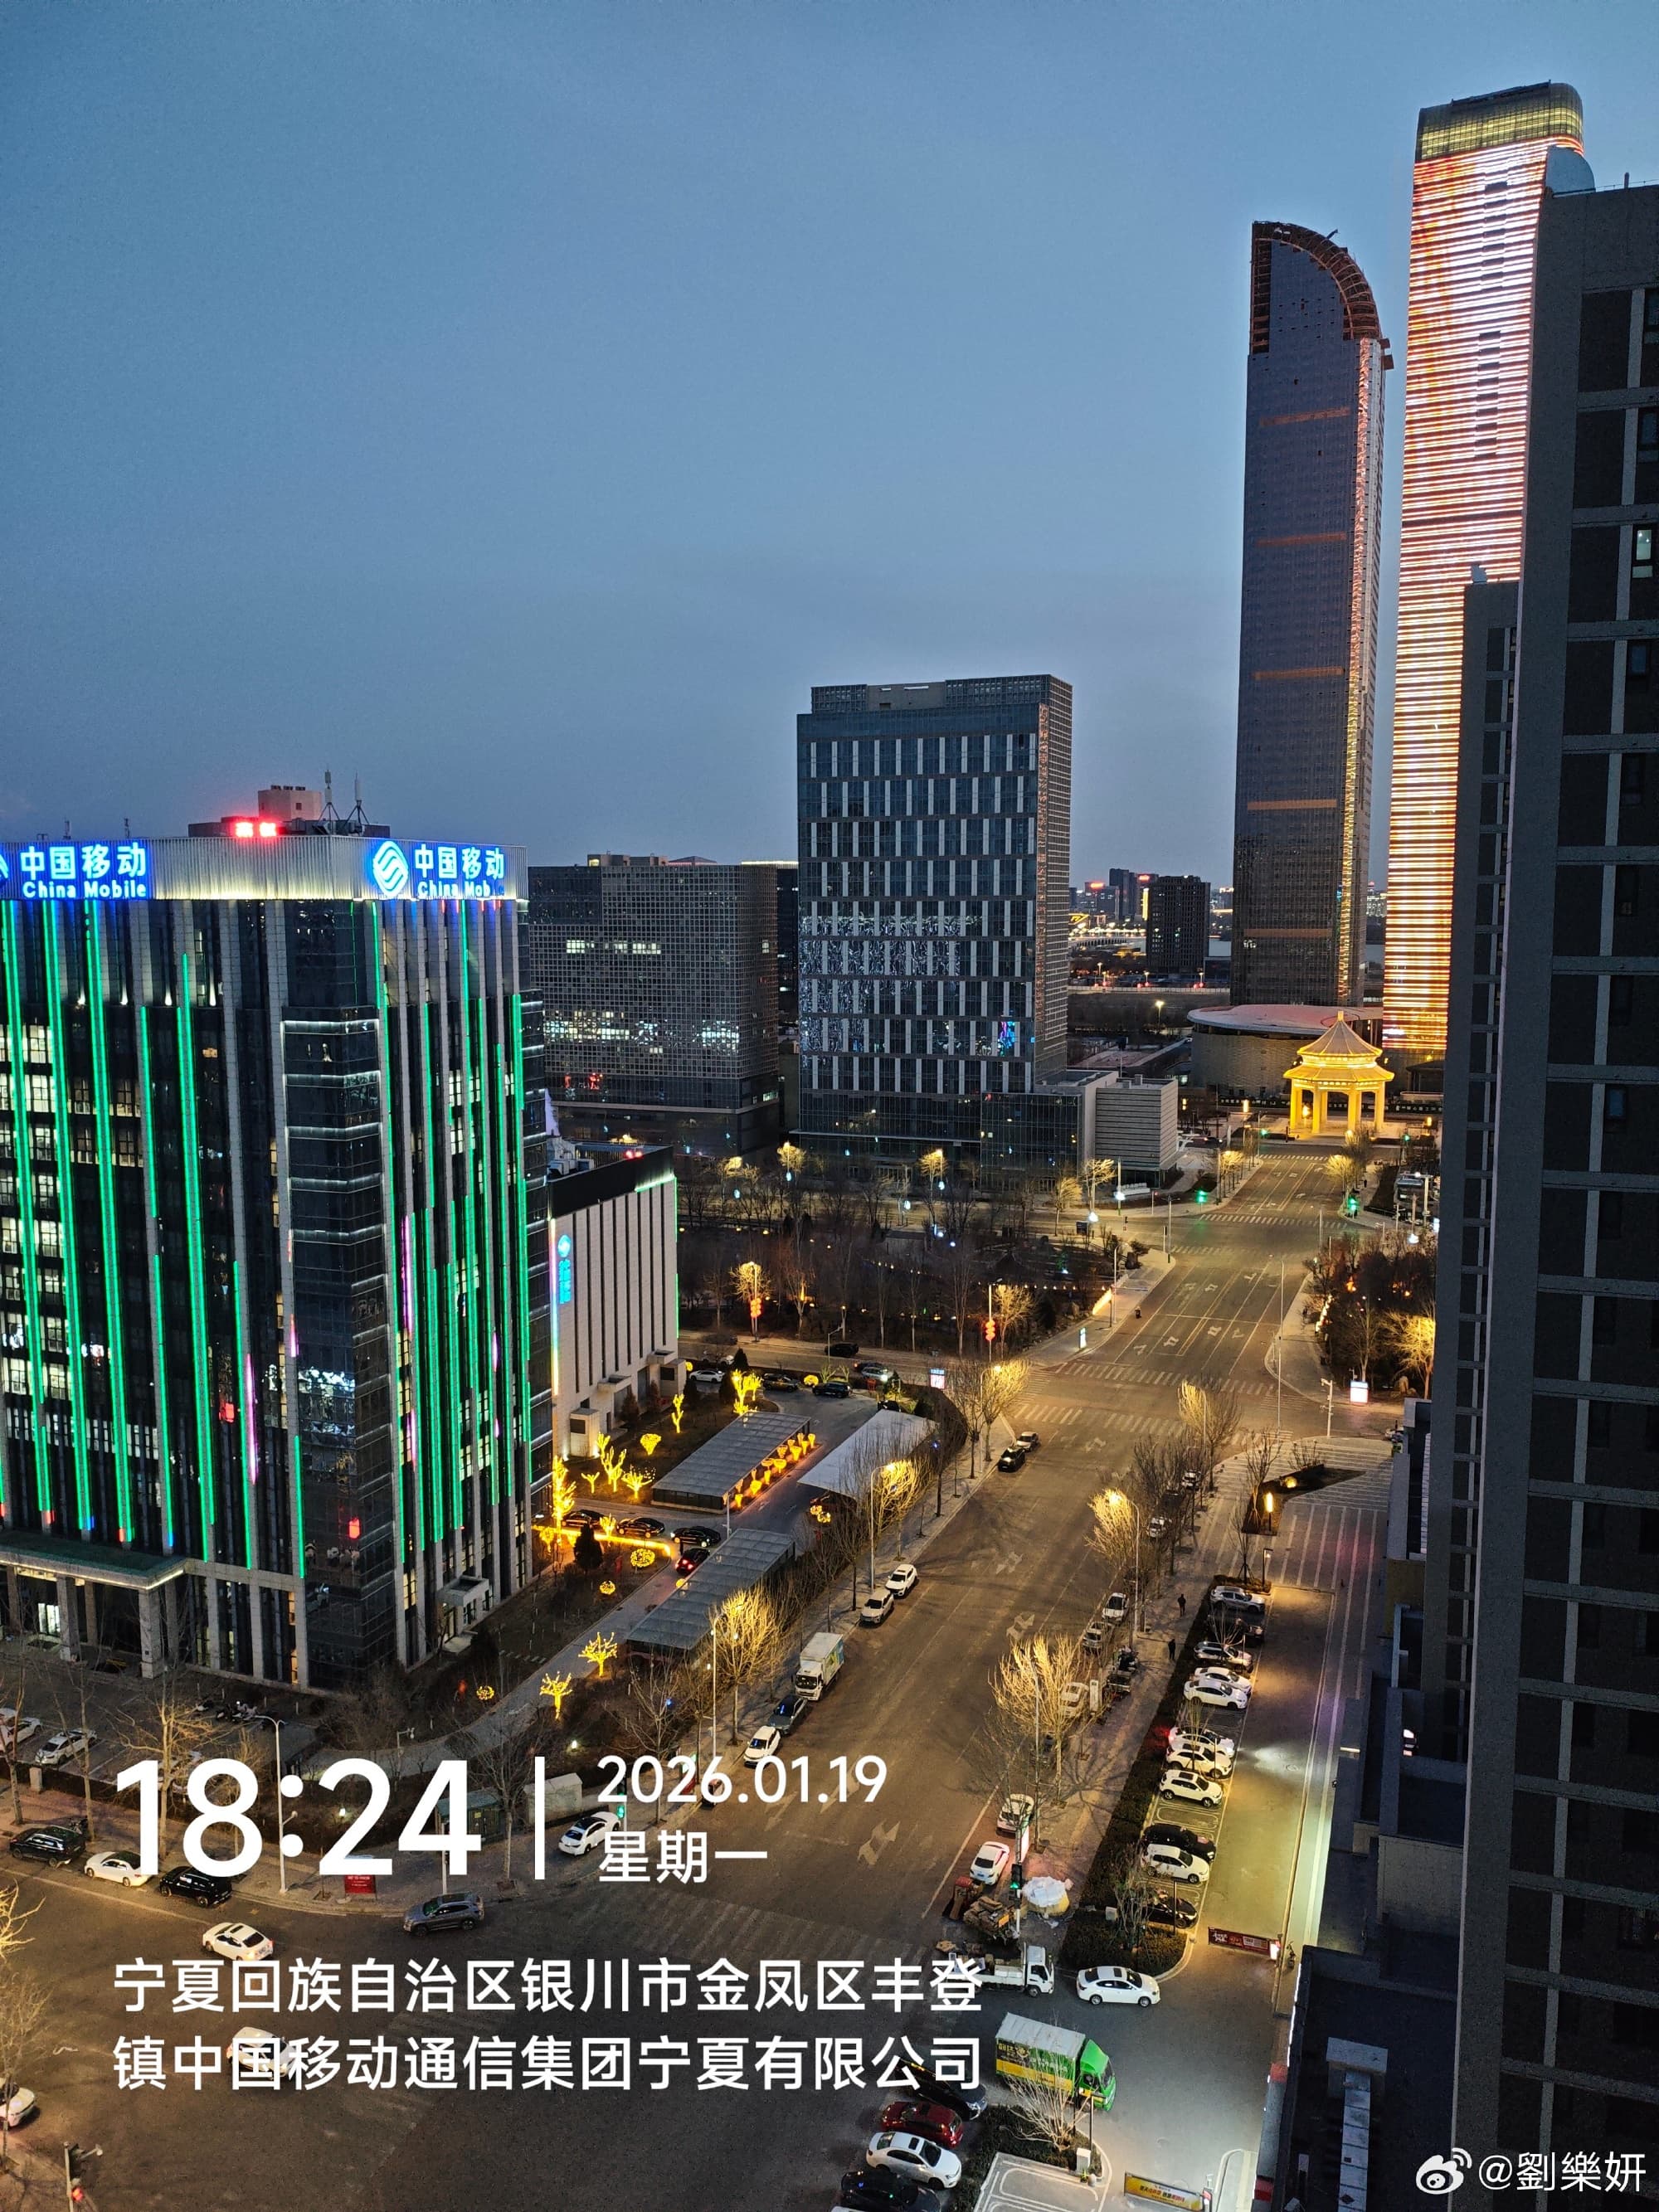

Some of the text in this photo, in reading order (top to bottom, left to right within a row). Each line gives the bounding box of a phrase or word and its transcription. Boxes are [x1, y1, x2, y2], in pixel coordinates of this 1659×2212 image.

[20, 842, 146, 881] 中国移动
[415, 843, 504, 880] 中国移动
[22, 879, 146, 898] China Mobile
